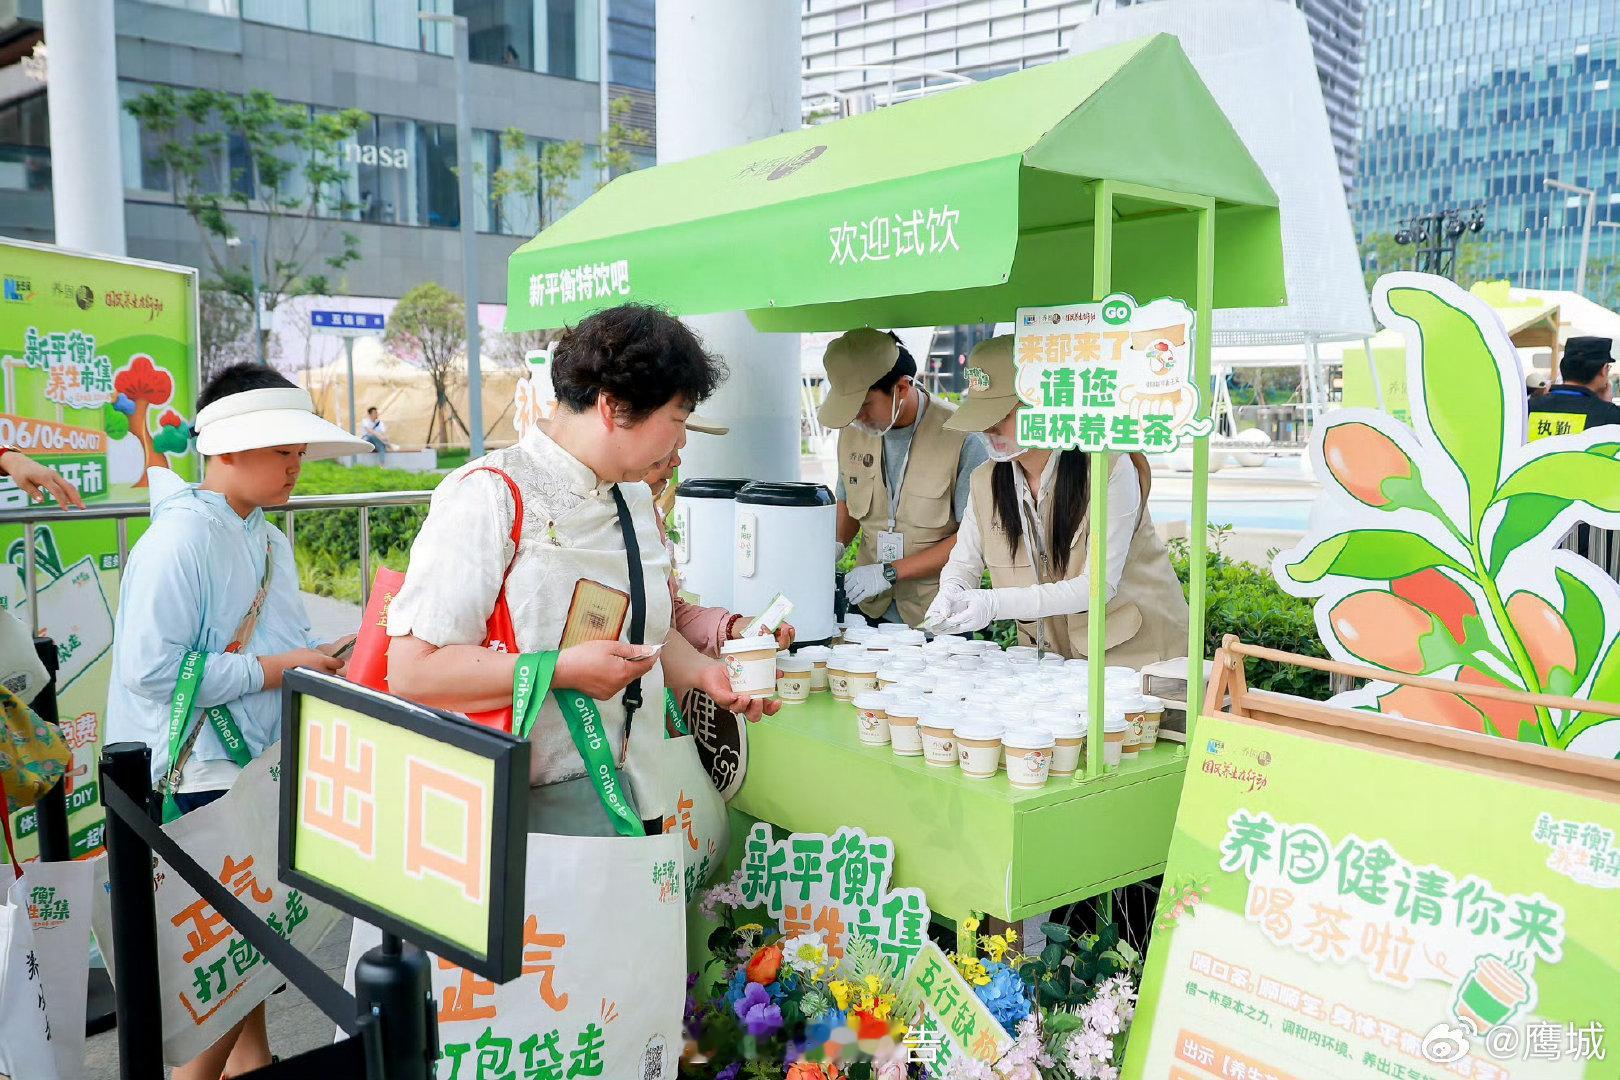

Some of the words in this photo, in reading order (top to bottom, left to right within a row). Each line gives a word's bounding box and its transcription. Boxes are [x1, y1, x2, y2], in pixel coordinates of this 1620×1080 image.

[828, 204, 961, 266] 欢迎试饮
[529, 259, 631, 307] 新平衡特饮吧
[1105, 307, 1128, 320] GO
[26, 328, 95, 367] 新平衡
[1018, 331, 1130, 364] 来都来了
[1040, 367, 1119, 408] 请您
[1020, 413, 1174, 447] 喝杯养生茶
[1537, 419, 1571, 436] 执勤
[169, 692, 184, 741] oriherb
[519, 665, 531, 728] oriherb
[210, 708, 240, 750] oriherb
[575, 697, 602, 751] oriherb
[72, 787, 94, 808] DIY
[302, 718, 487, 904] 出口
[599, 764, 628, 817] oriherb
[1534, 814, 1612, 852] 新平衡
[741, 828, 889, 912] 新平衡
[1224, 813, 1566, 960] 养固健请你来
[1250, 885, 1416, 983] 喝茶啦
